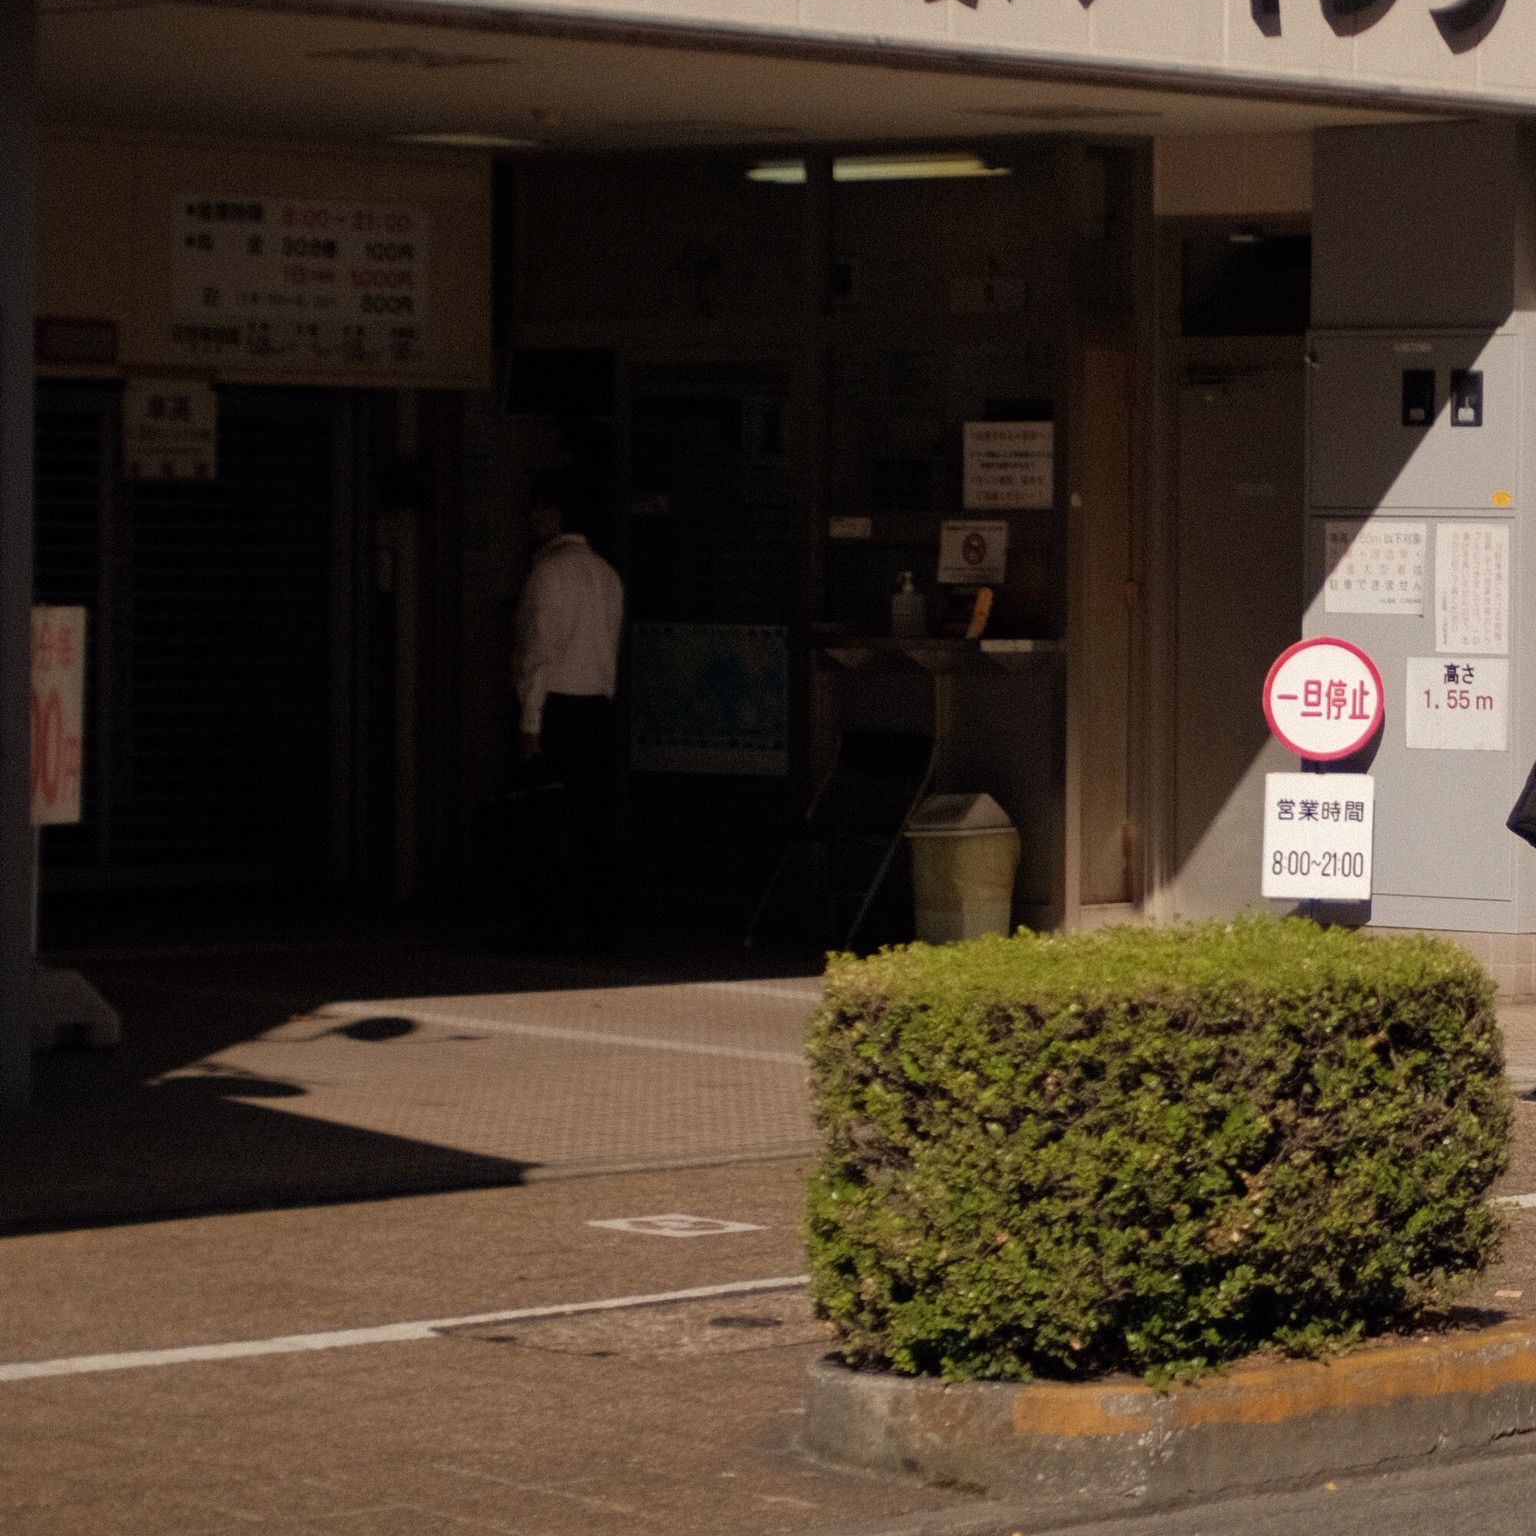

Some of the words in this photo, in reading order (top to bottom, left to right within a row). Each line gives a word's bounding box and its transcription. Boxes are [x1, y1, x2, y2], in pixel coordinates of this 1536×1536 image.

[1444, 663, 1474, 684] 高さ
[1277, 679, 1370, 720] 一旦停止
[1276, 799, 1365, 823] 営業時間
[1272, 850, 1364, 877] 8:00~21:00
